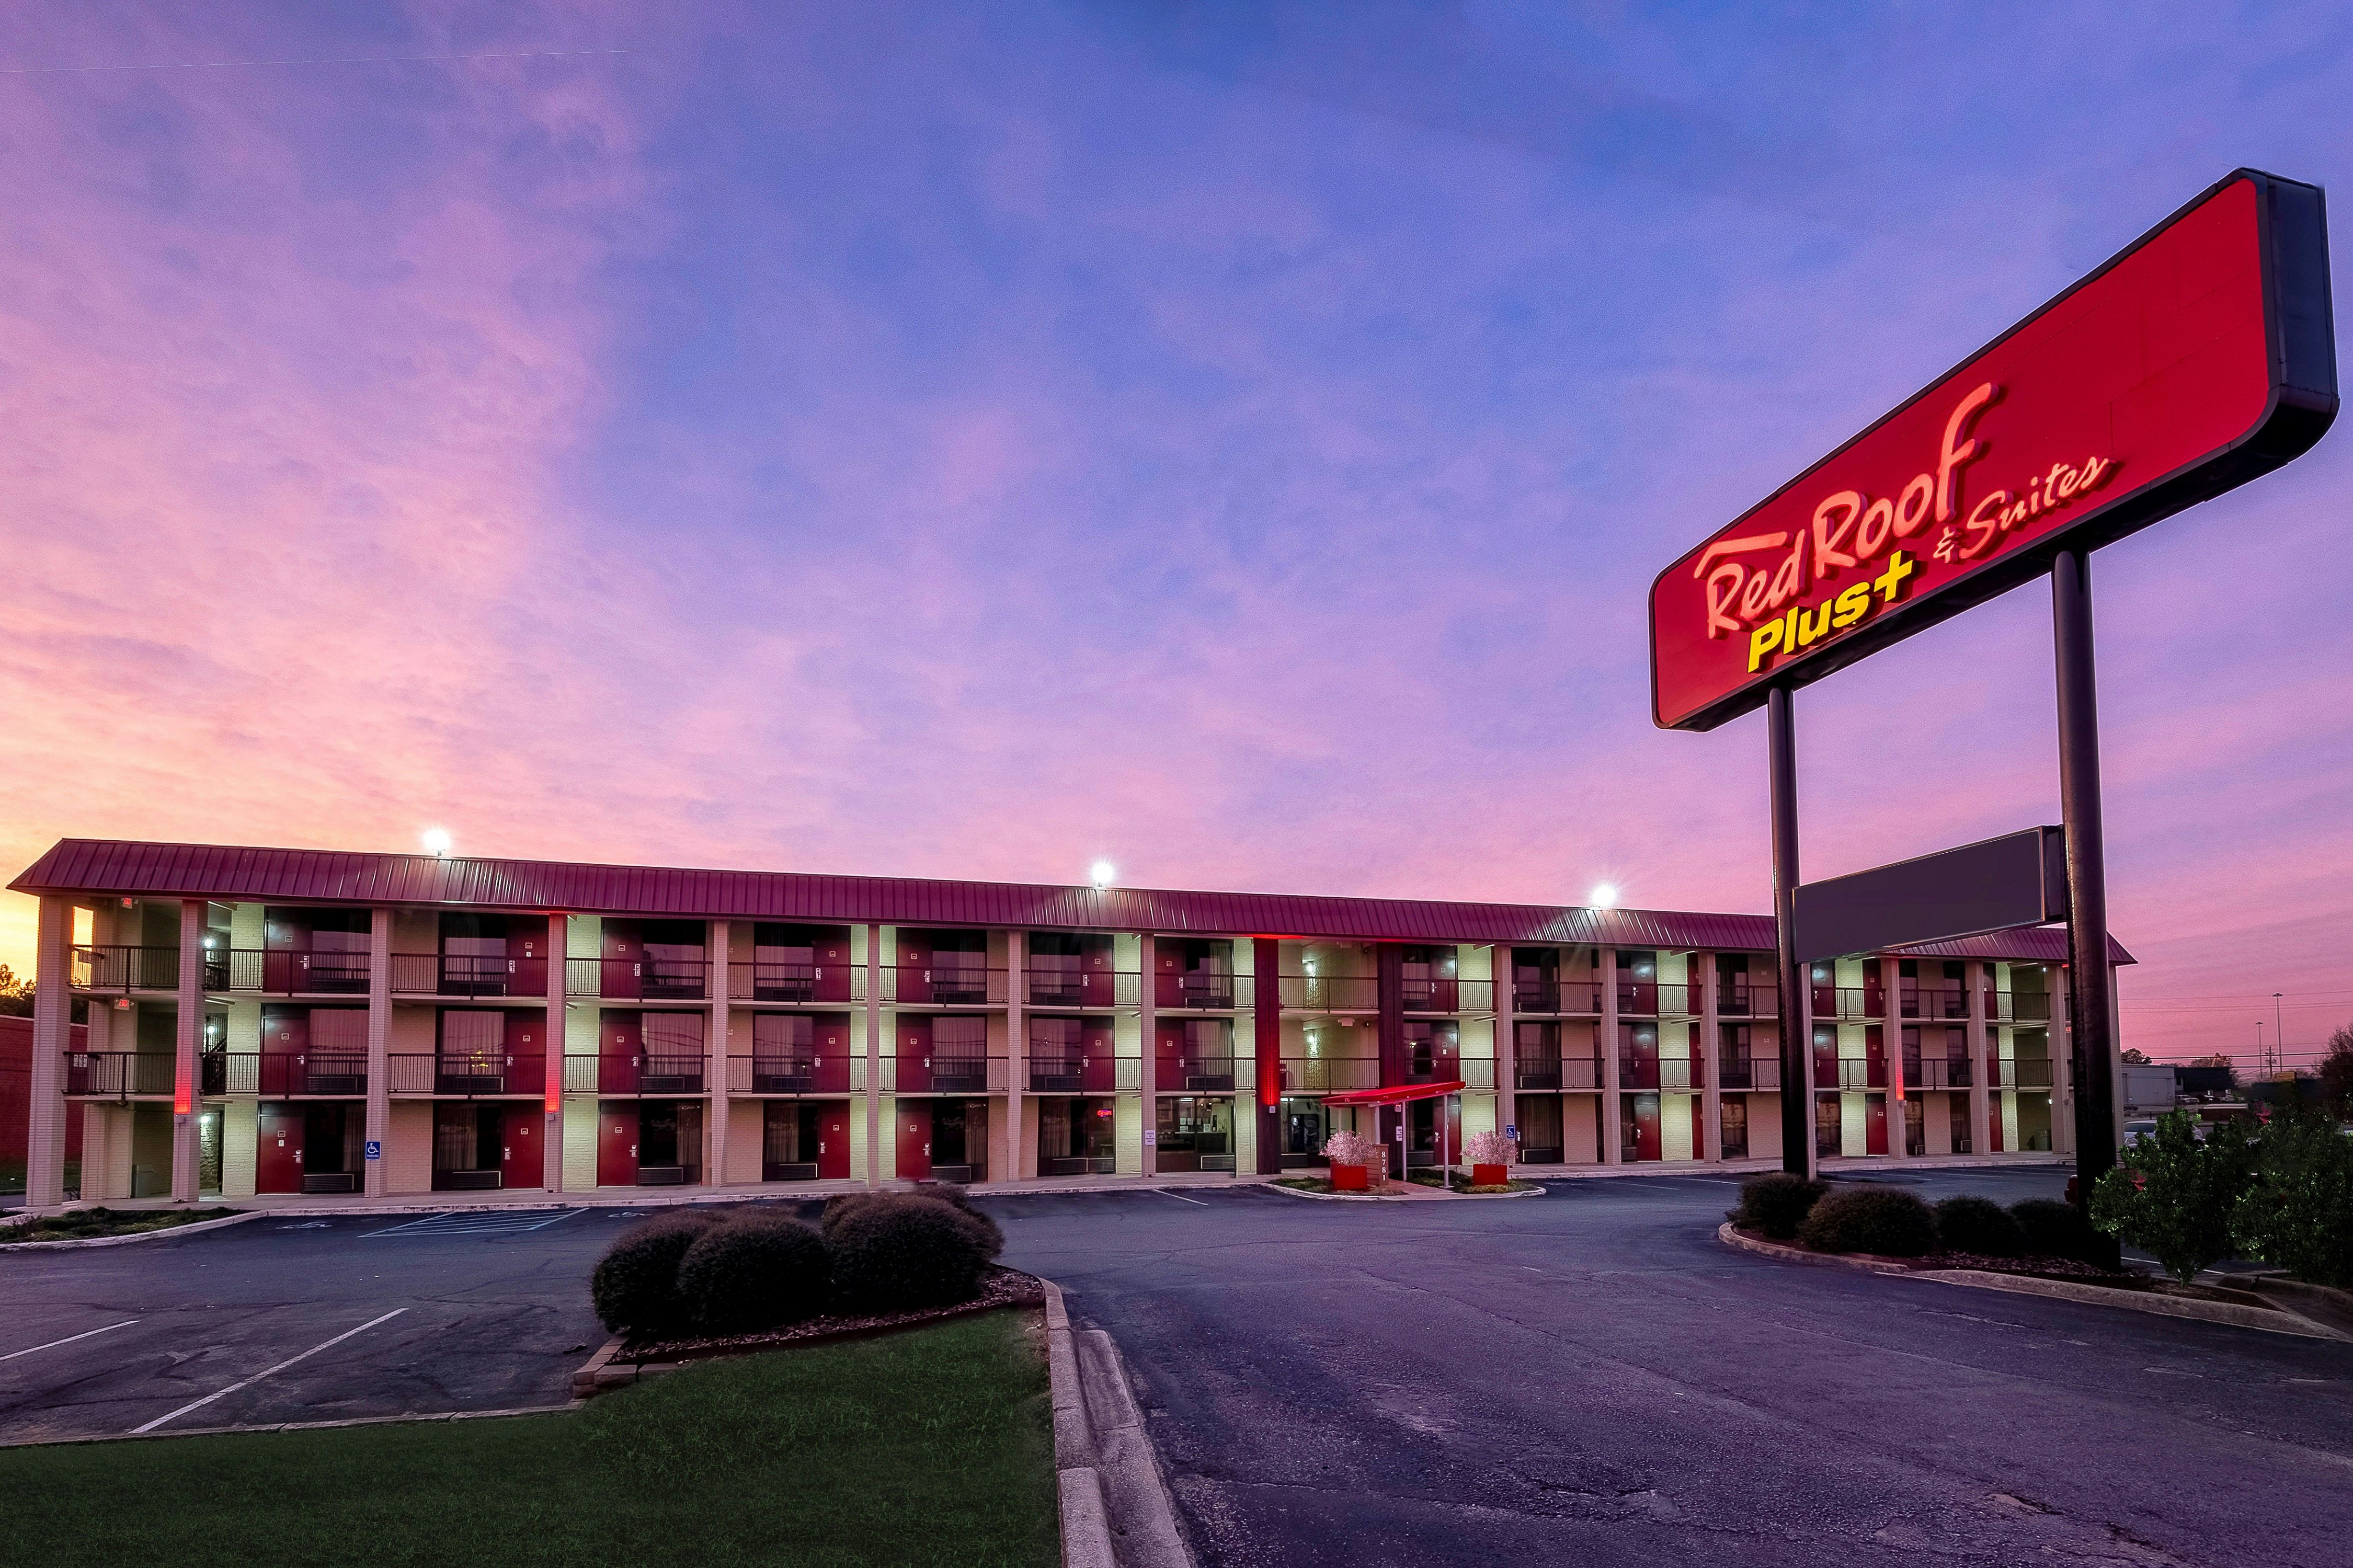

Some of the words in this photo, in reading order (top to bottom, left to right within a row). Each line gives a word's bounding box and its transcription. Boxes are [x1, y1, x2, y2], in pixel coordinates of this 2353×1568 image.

[1707, 529, 1811, 639] Red
[1812, 382, 1997, 579] Roof
[1933, 525, 1959, 564] &
[1959, 456, 2110, 559] Suites
[1747, 549, 1914, 673] Plus+
